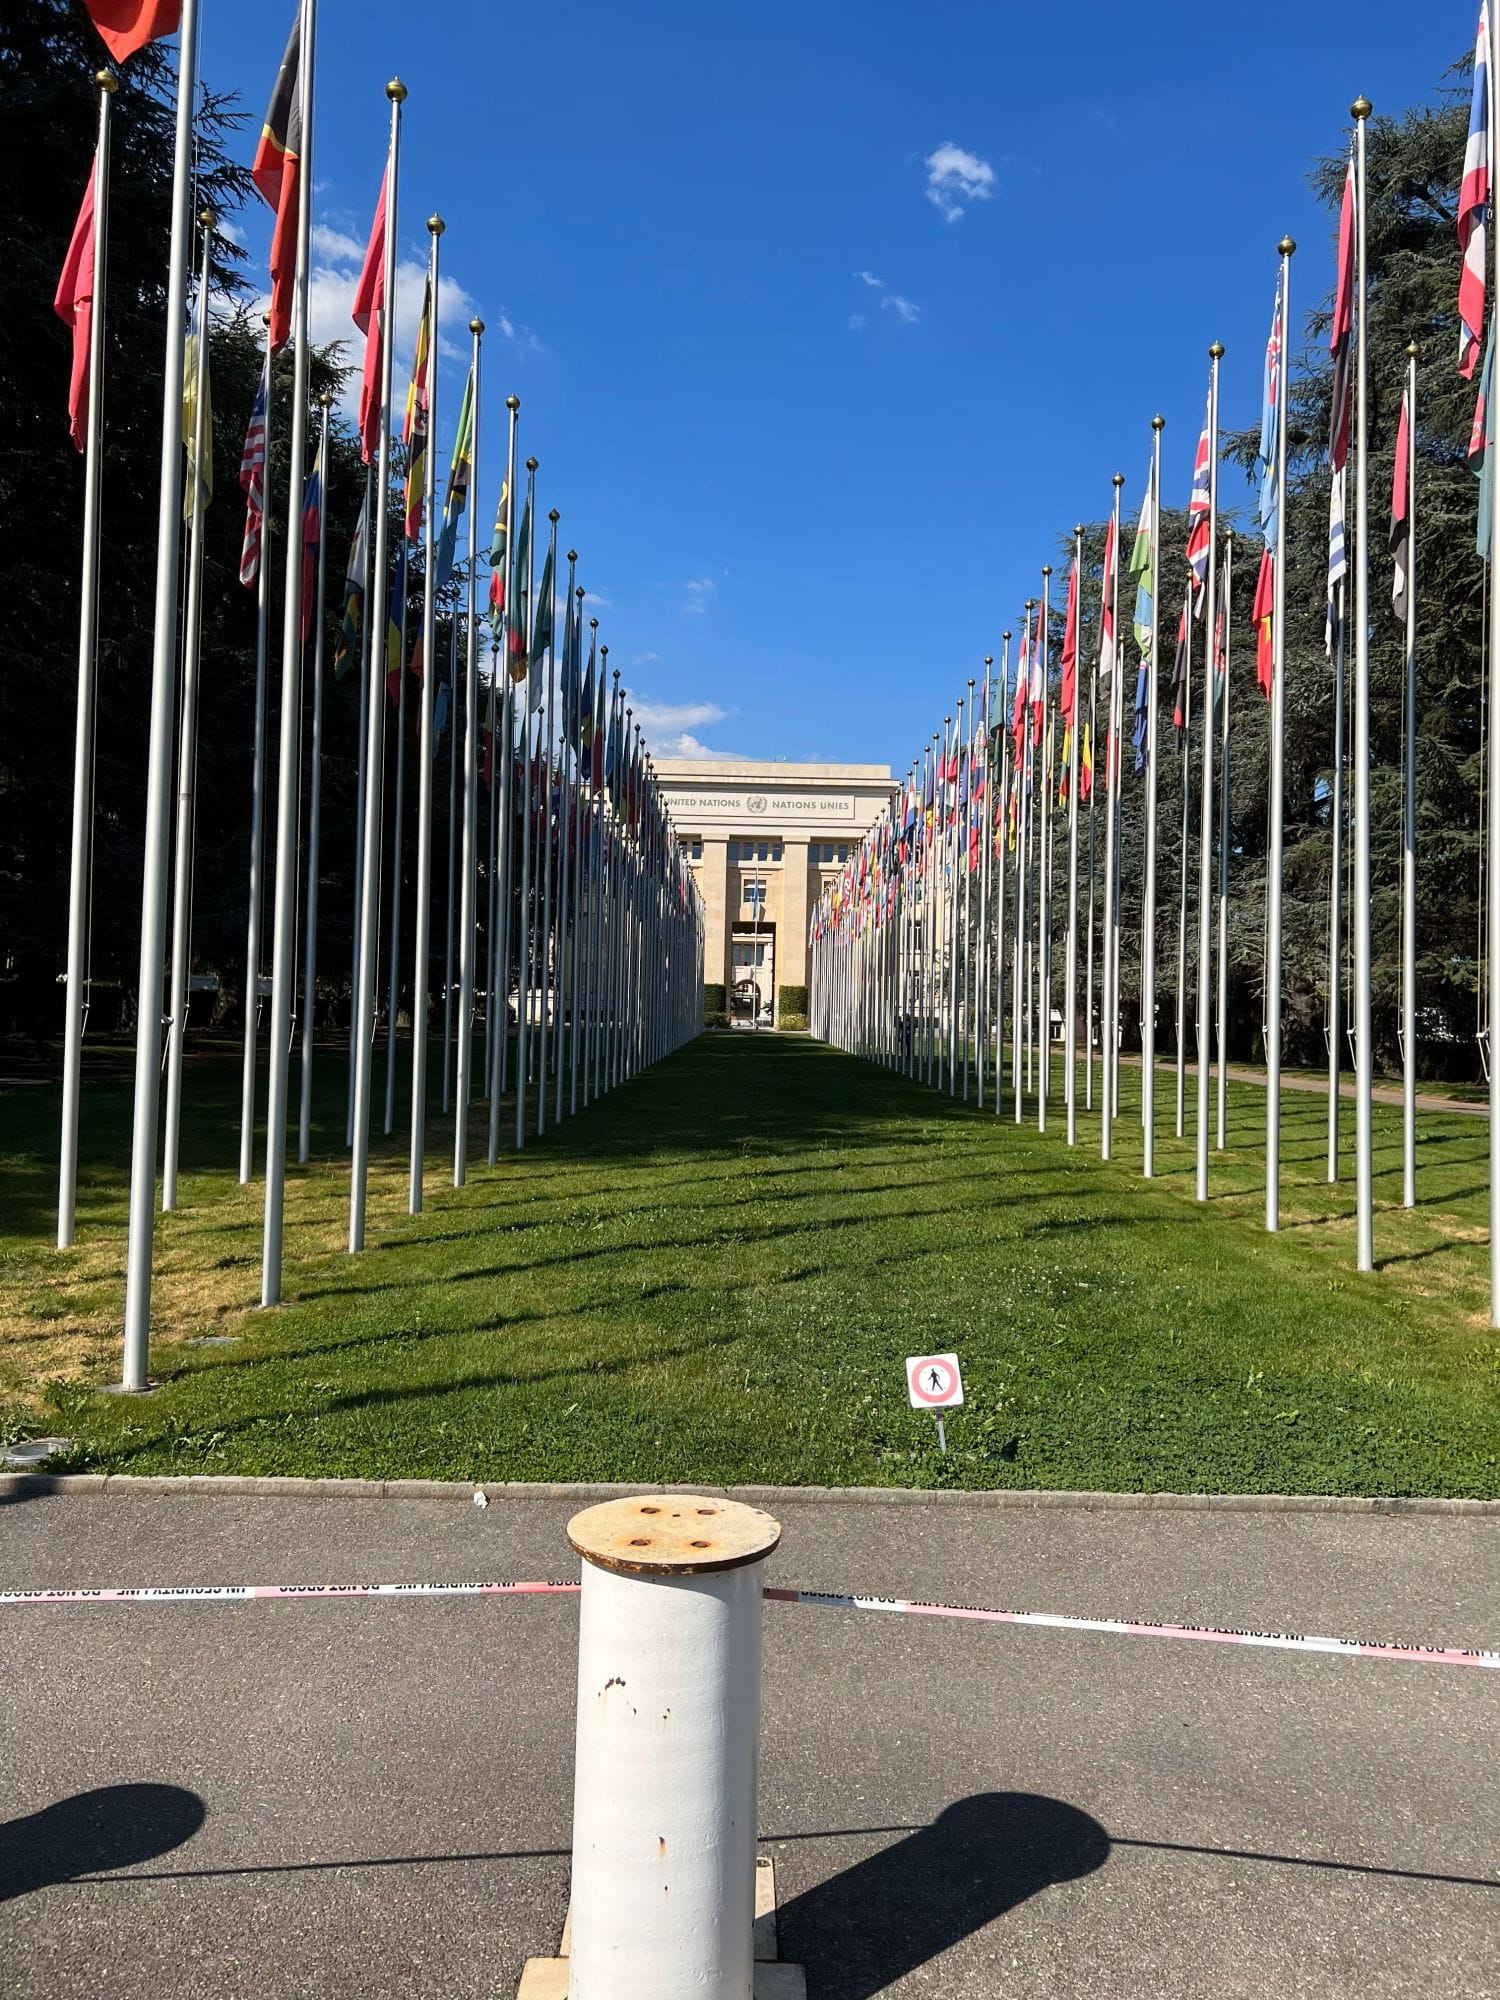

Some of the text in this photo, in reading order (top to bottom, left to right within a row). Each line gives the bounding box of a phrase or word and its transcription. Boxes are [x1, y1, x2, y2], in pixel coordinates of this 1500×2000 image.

[699, 799, 741, 808] NATIONS
[772, 801, 849, 811] NATIONS UNIES
